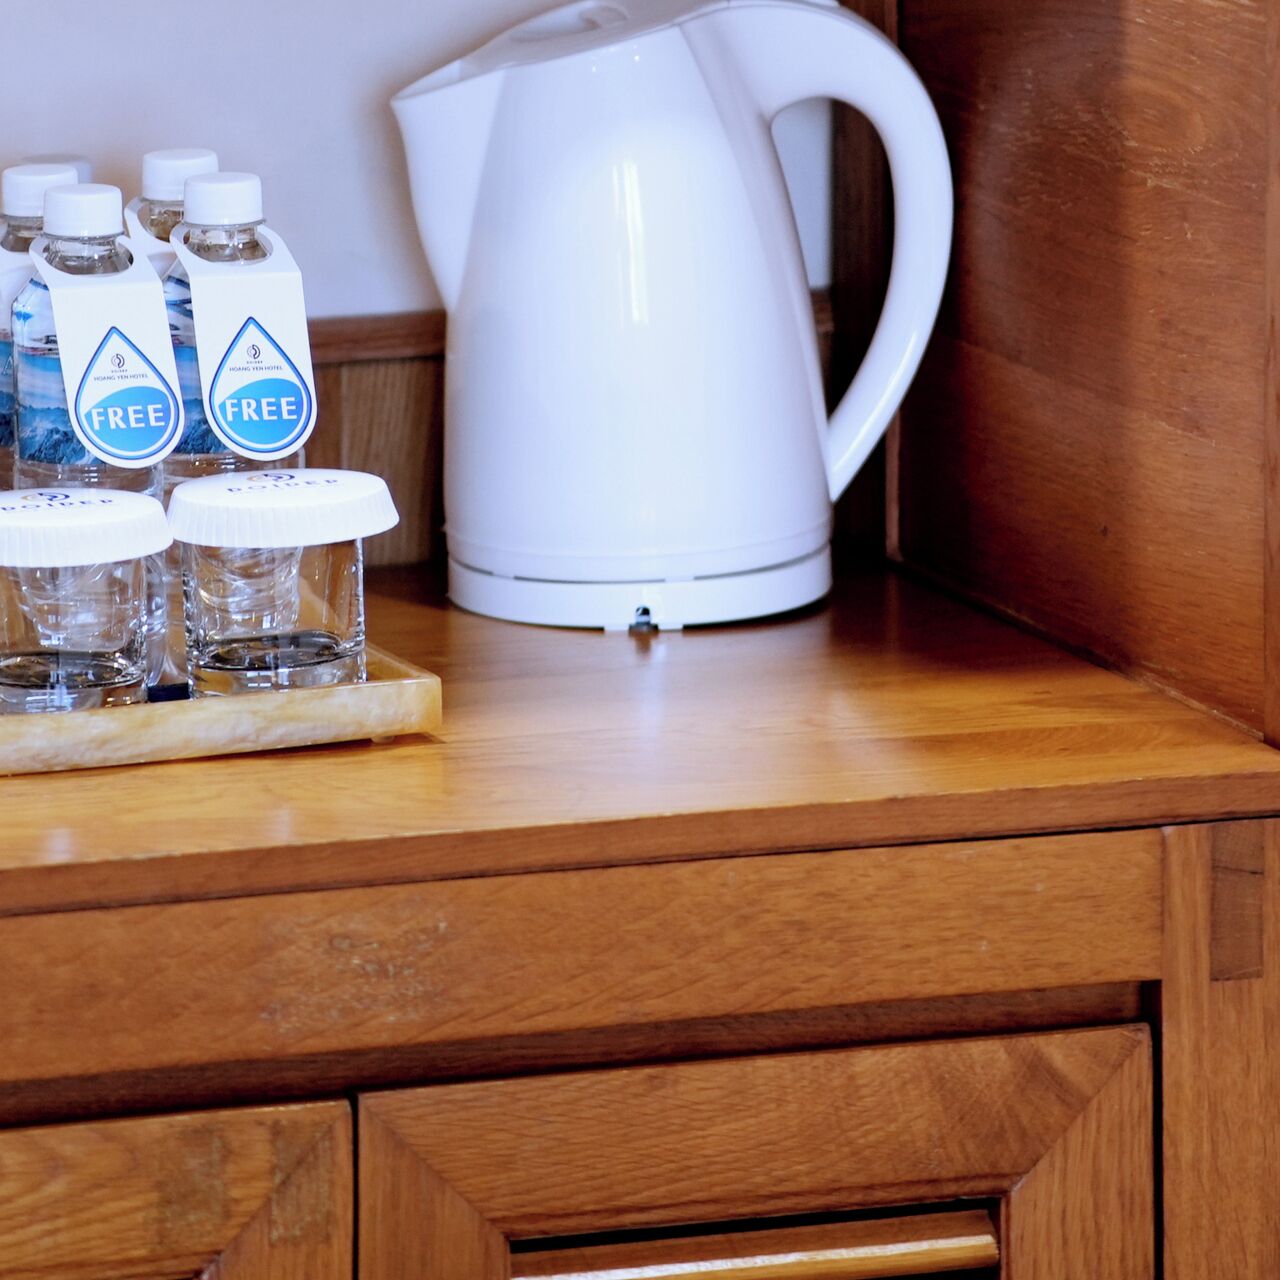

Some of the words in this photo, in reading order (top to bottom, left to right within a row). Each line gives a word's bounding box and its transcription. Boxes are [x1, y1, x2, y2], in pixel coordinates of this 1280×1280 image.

[91, 404, 165, 431] FREE
[225, 396, 298, 422] FREE
[227, 479, 338, 492] DOIDEP
[0, 498, 114, 512] DOIDEP
